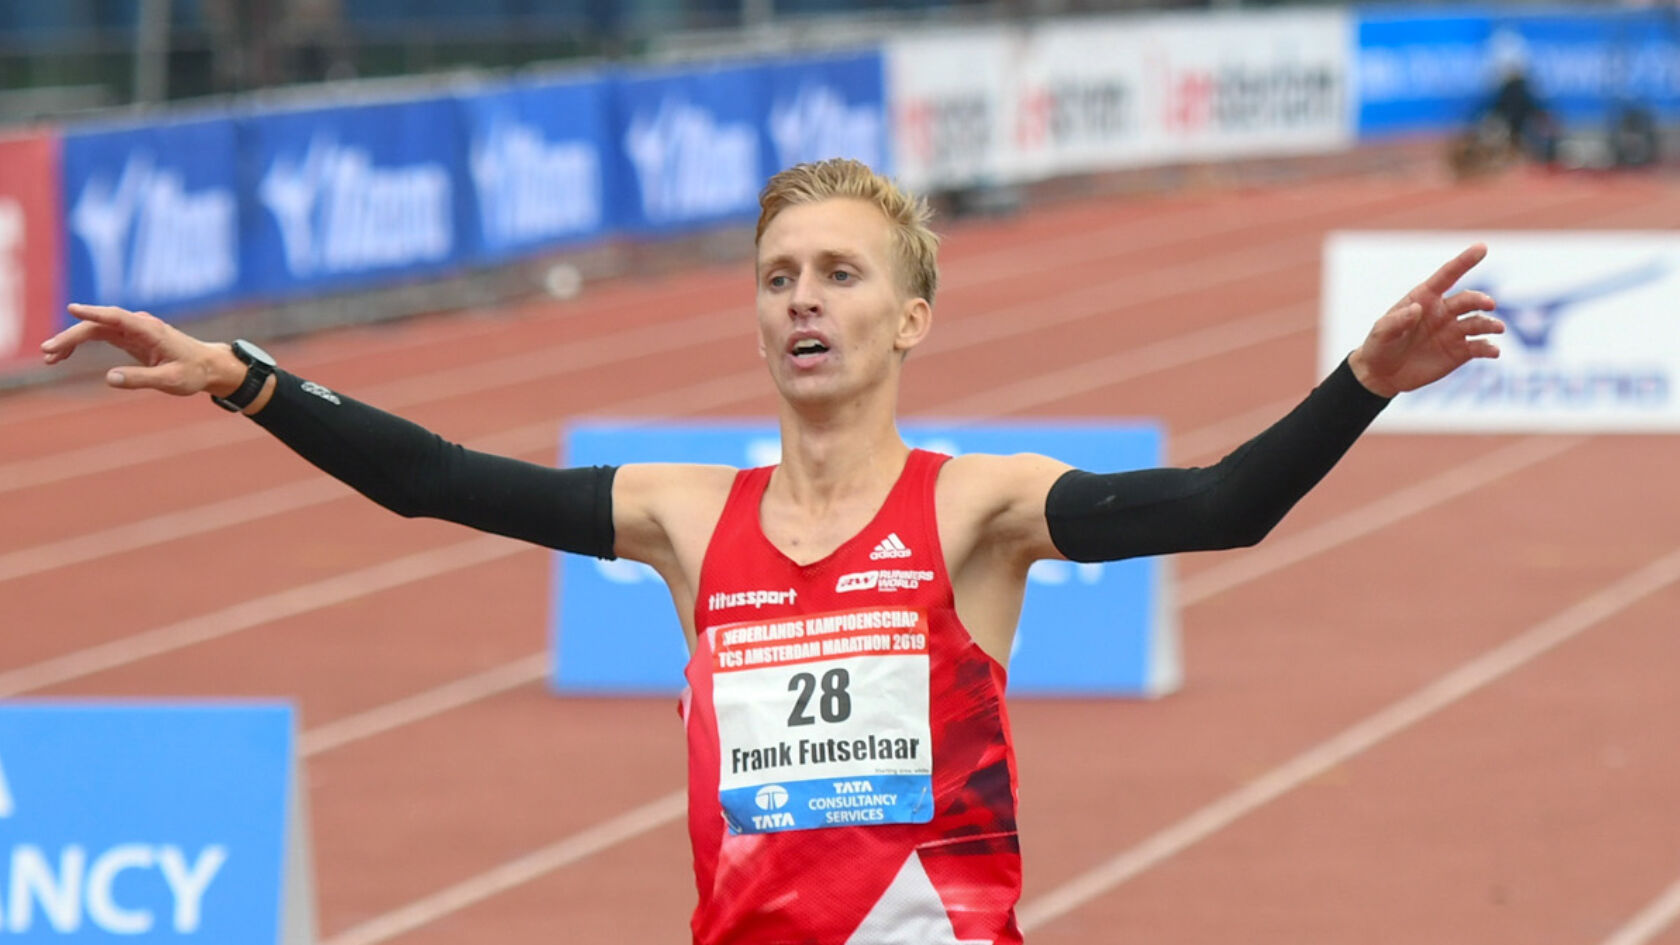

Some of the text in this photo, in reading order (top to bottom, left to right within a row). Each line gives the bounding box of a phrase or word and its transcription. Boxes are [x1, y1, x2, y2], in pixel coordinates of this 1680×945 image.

[869, 547, 912, 560] adidas
[878, 579, 919, 590] WORLD
[708, 588, 798, 611] titussport
[723, 611, 919, 647] NEDERLANDS KAMPIOENSCHAP
[718, 633, 926, 668] TCS AMSTERDAM MARATHON 2019
[787, 668, 852, 727] 28
[732, 735, 920, 774] Frank Futselaar
[833, 780, 873, 794] TATA
[808, 794, 898, 811] CONSULTANCY
[752, 808, 884, 830] TATA SERVICES
